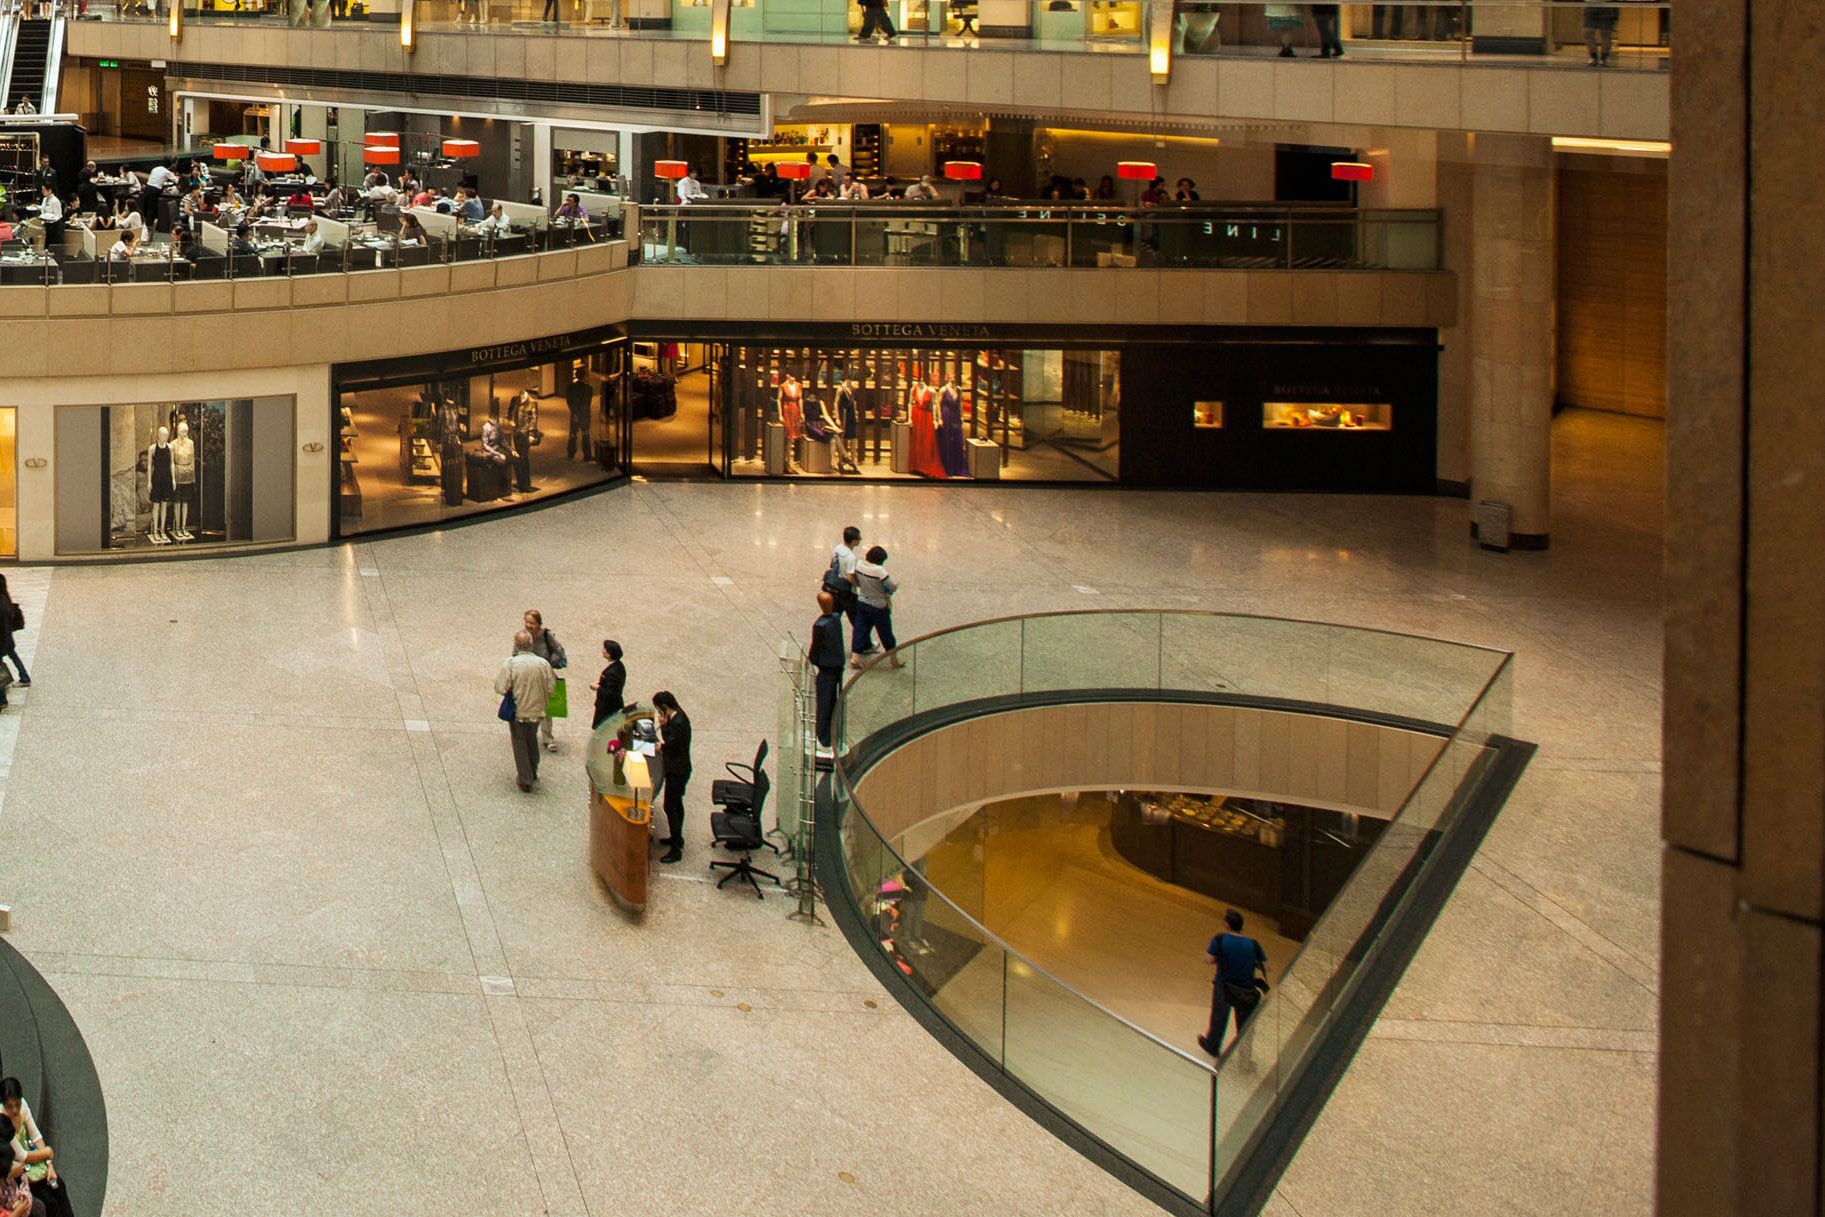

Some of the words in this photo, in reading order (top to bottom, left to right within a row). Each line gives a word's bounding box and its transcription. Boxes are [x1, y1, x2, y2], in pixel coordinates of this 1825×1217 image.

[852, 324, 922, 336] BOTTEGA
[472, 345, 526, 362] BOTTEGA
[530, 336, 571, 352] VENETA
